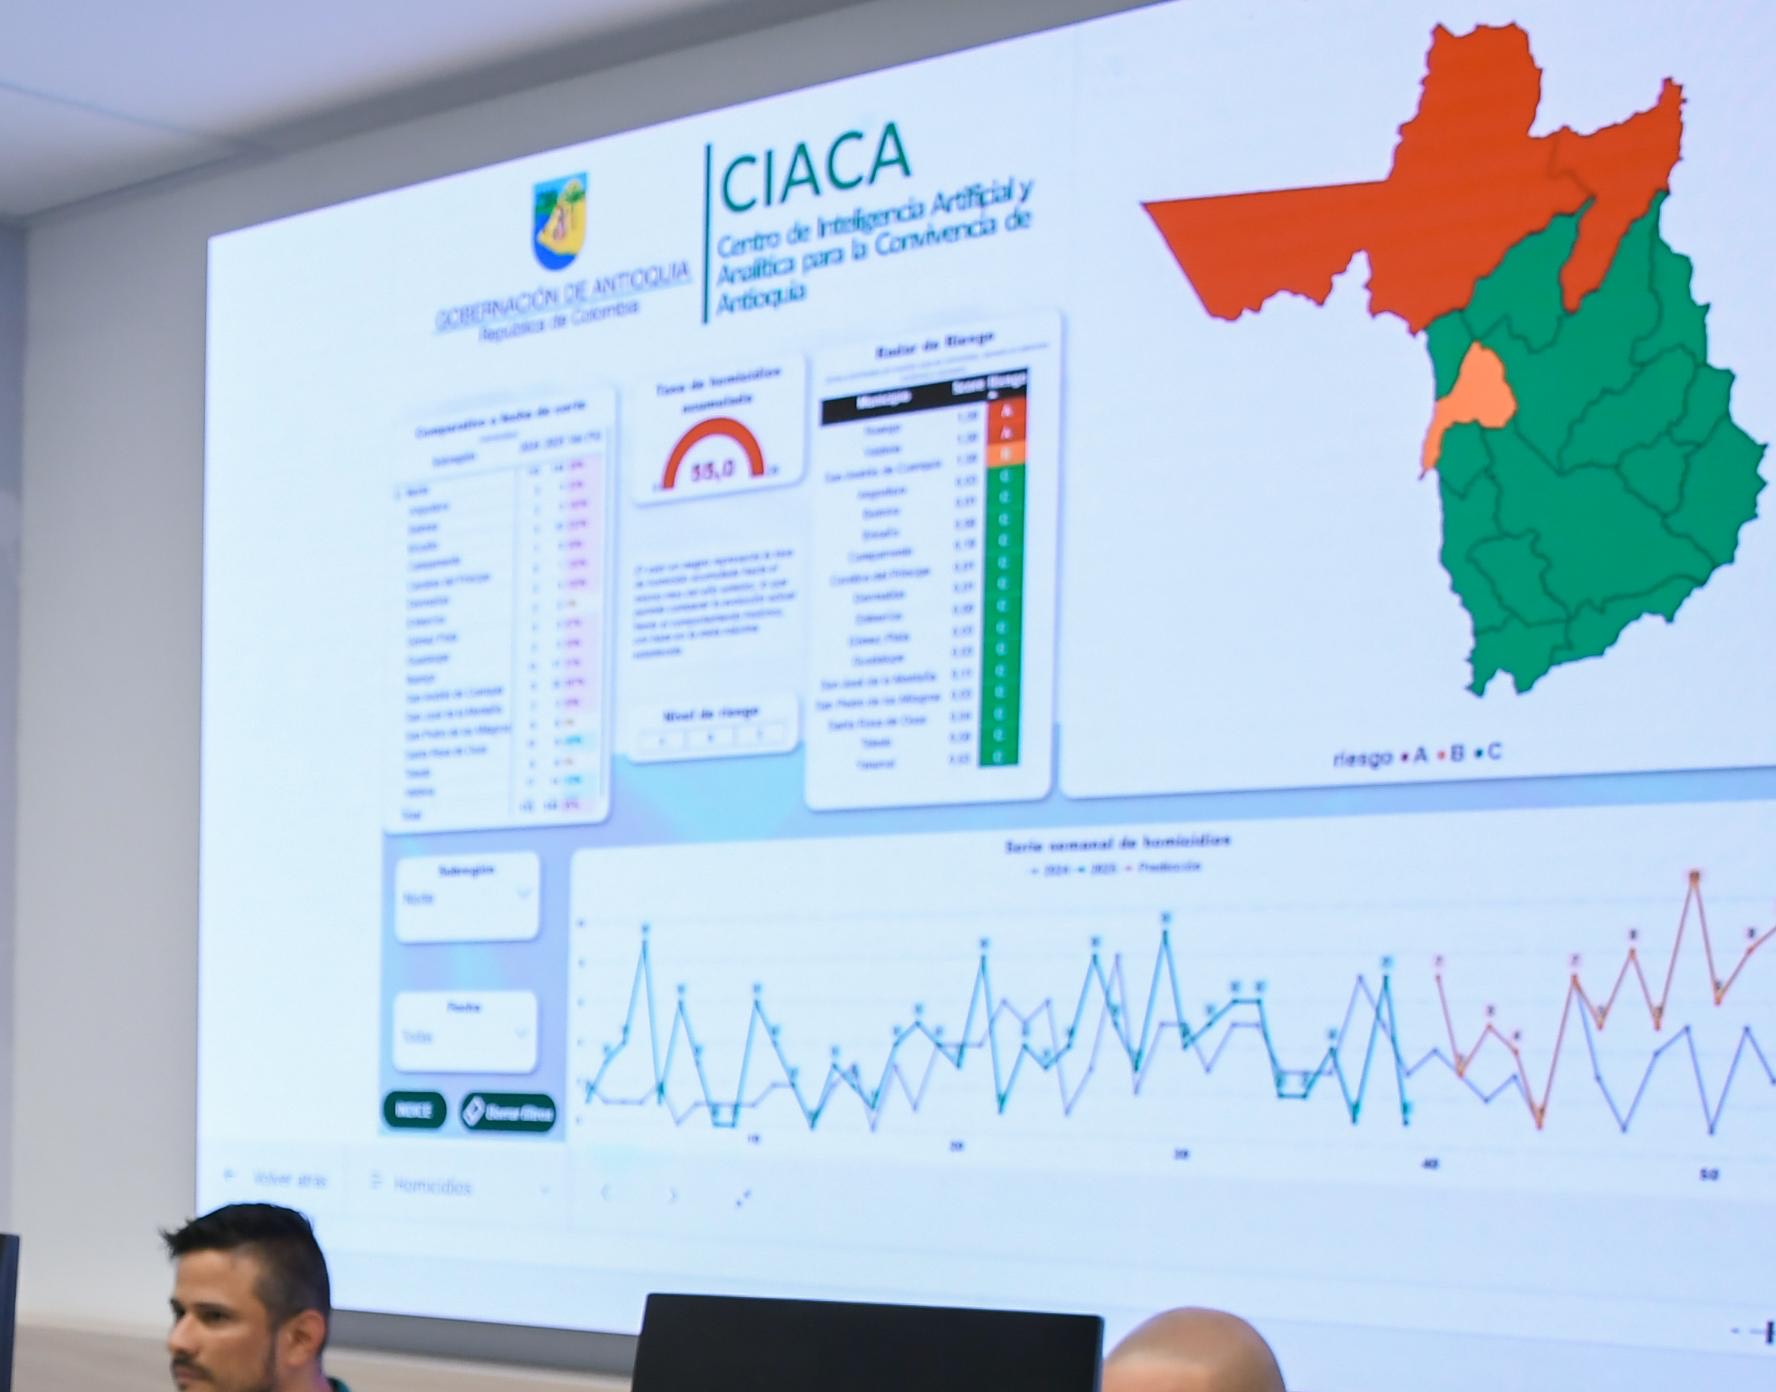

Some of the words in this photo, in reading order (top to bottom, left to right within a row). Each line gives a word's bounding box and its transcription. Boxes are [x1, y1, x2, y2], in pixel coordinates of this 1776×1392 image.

[720, 121, 912, 213] CIACA
[718, 229, 780, 258] Centro
[787, 220, 810, 243] de
[818, 200, 925, 239] Inteligencia
[931, 177, 1015, 215] Artificial
[1019, 178, 1034, 204] y
[802, 247, 844, 275] para
[851, 239, 867, 261] la
[874, 215, 997, 256] Convivencia
[1005, 207, 1032, 230] de
[564, 279, 587, 300] DE
[718, 281, 808, 314] Antioquia
[1333, 751, 1394, 770] riesgo
[1414, 746, 1428, 763] A
[1450, 743, 1465, 763] B
[1487, 742, 1502, 760] C
